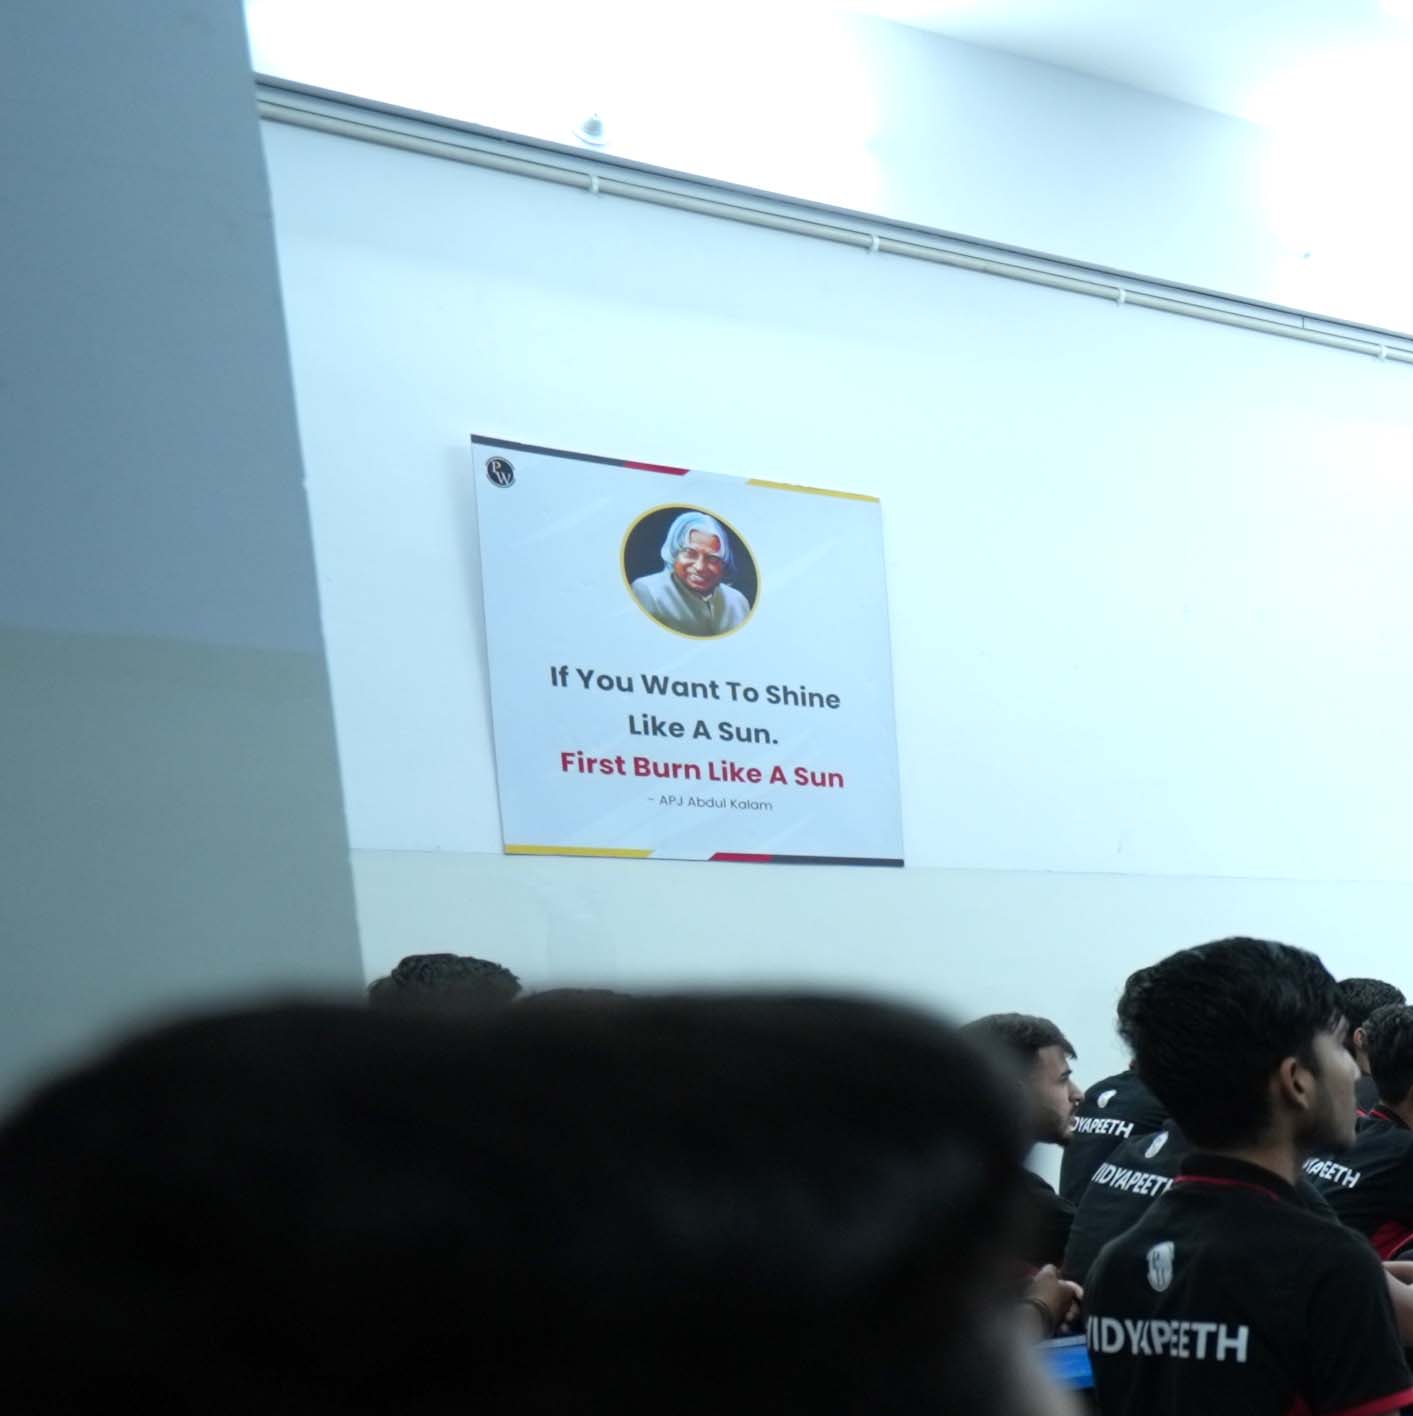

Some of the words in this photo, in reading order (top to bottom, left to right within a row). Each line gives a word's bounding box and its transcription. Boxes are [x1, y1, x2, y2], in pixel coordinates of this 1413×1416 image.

[551, 666, 568, 688] If
[576, 668, 634, 694] You
[641, 675, 720, 701] Want
[726, 682, 759, 704] To
[766, 685, 841, 710] Shine
[629, 714, 685, 739] Like
[692, 720, 711, 739] A
[718, 721, 779, 745] Sun.
[560, 752, 626, 777] First
[634, 756, 701, 780] Burn
[708, 761, 761, 784] Like
[769, 765, 788, 785] A
[794, 766, 844, 789] Sun
[659, 795, 684, 807] APJ
[688, 796, 726, 810] Abdul
[729, 798, 773, 812] Kalam
[1071, 1116, 1134, 1139] DYAPEETH
